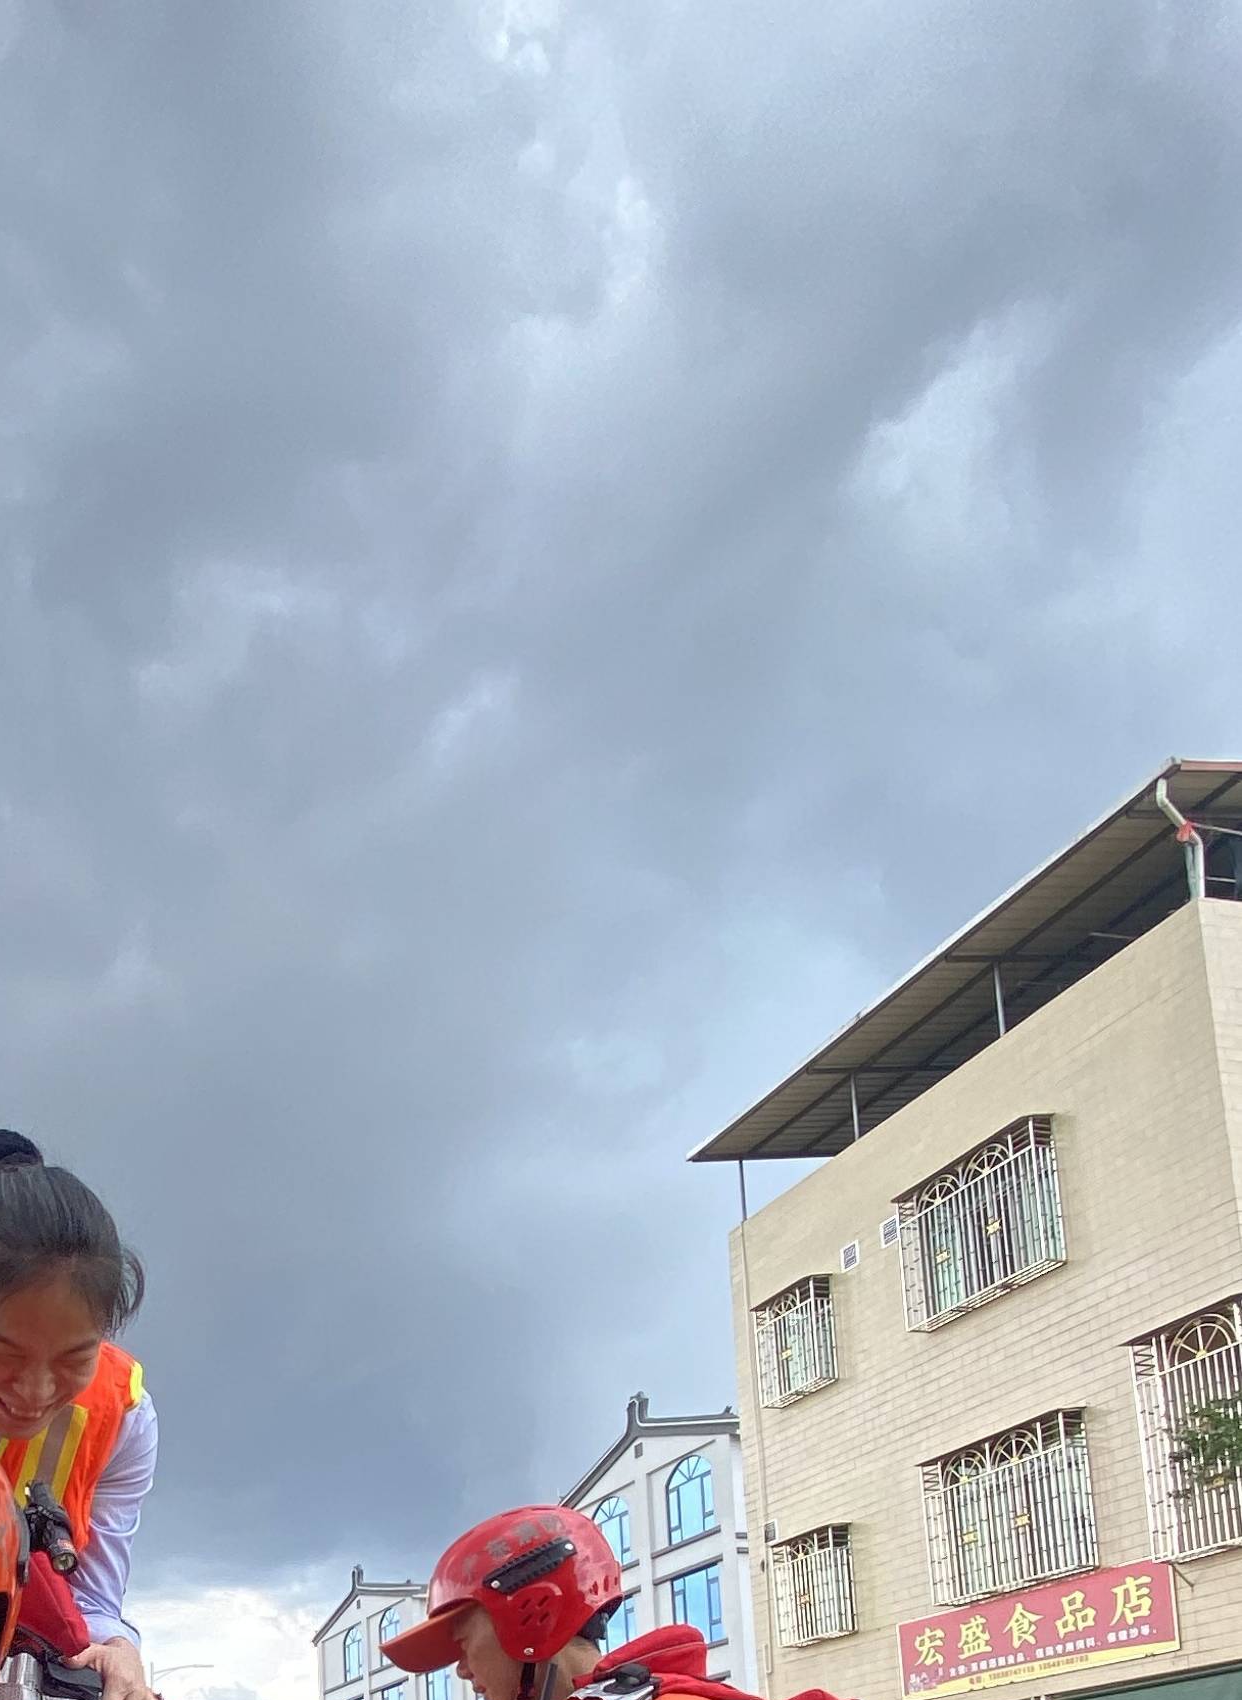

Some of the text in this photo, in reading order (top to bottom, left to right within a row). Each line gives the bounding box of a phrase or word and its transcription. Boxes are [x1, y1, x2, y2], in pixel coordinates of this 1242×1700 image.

[913, 1575, 1153, 1667] 宏盛食品店
